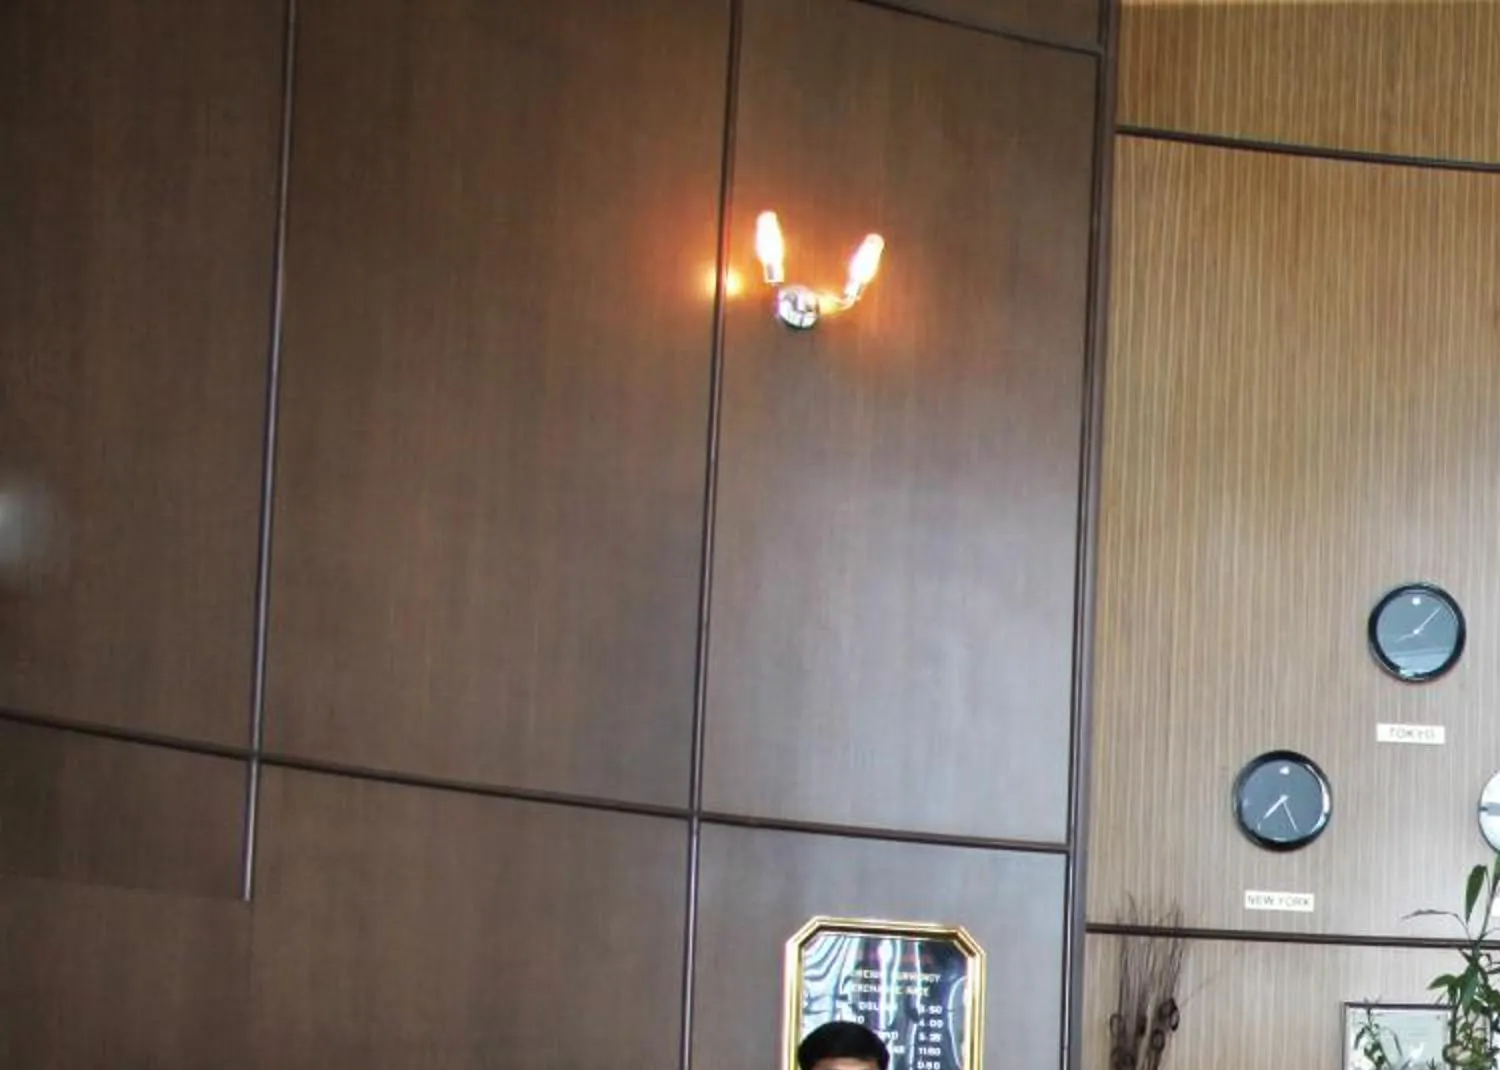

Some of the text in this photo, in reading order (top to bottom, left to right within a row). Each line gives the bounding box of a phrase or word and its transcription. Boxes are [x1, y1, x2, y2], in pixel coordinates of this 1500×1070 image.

[1390, 727, 1435, 740] TOKYO
[1247, 894, 1311, 907] NEW YORK
